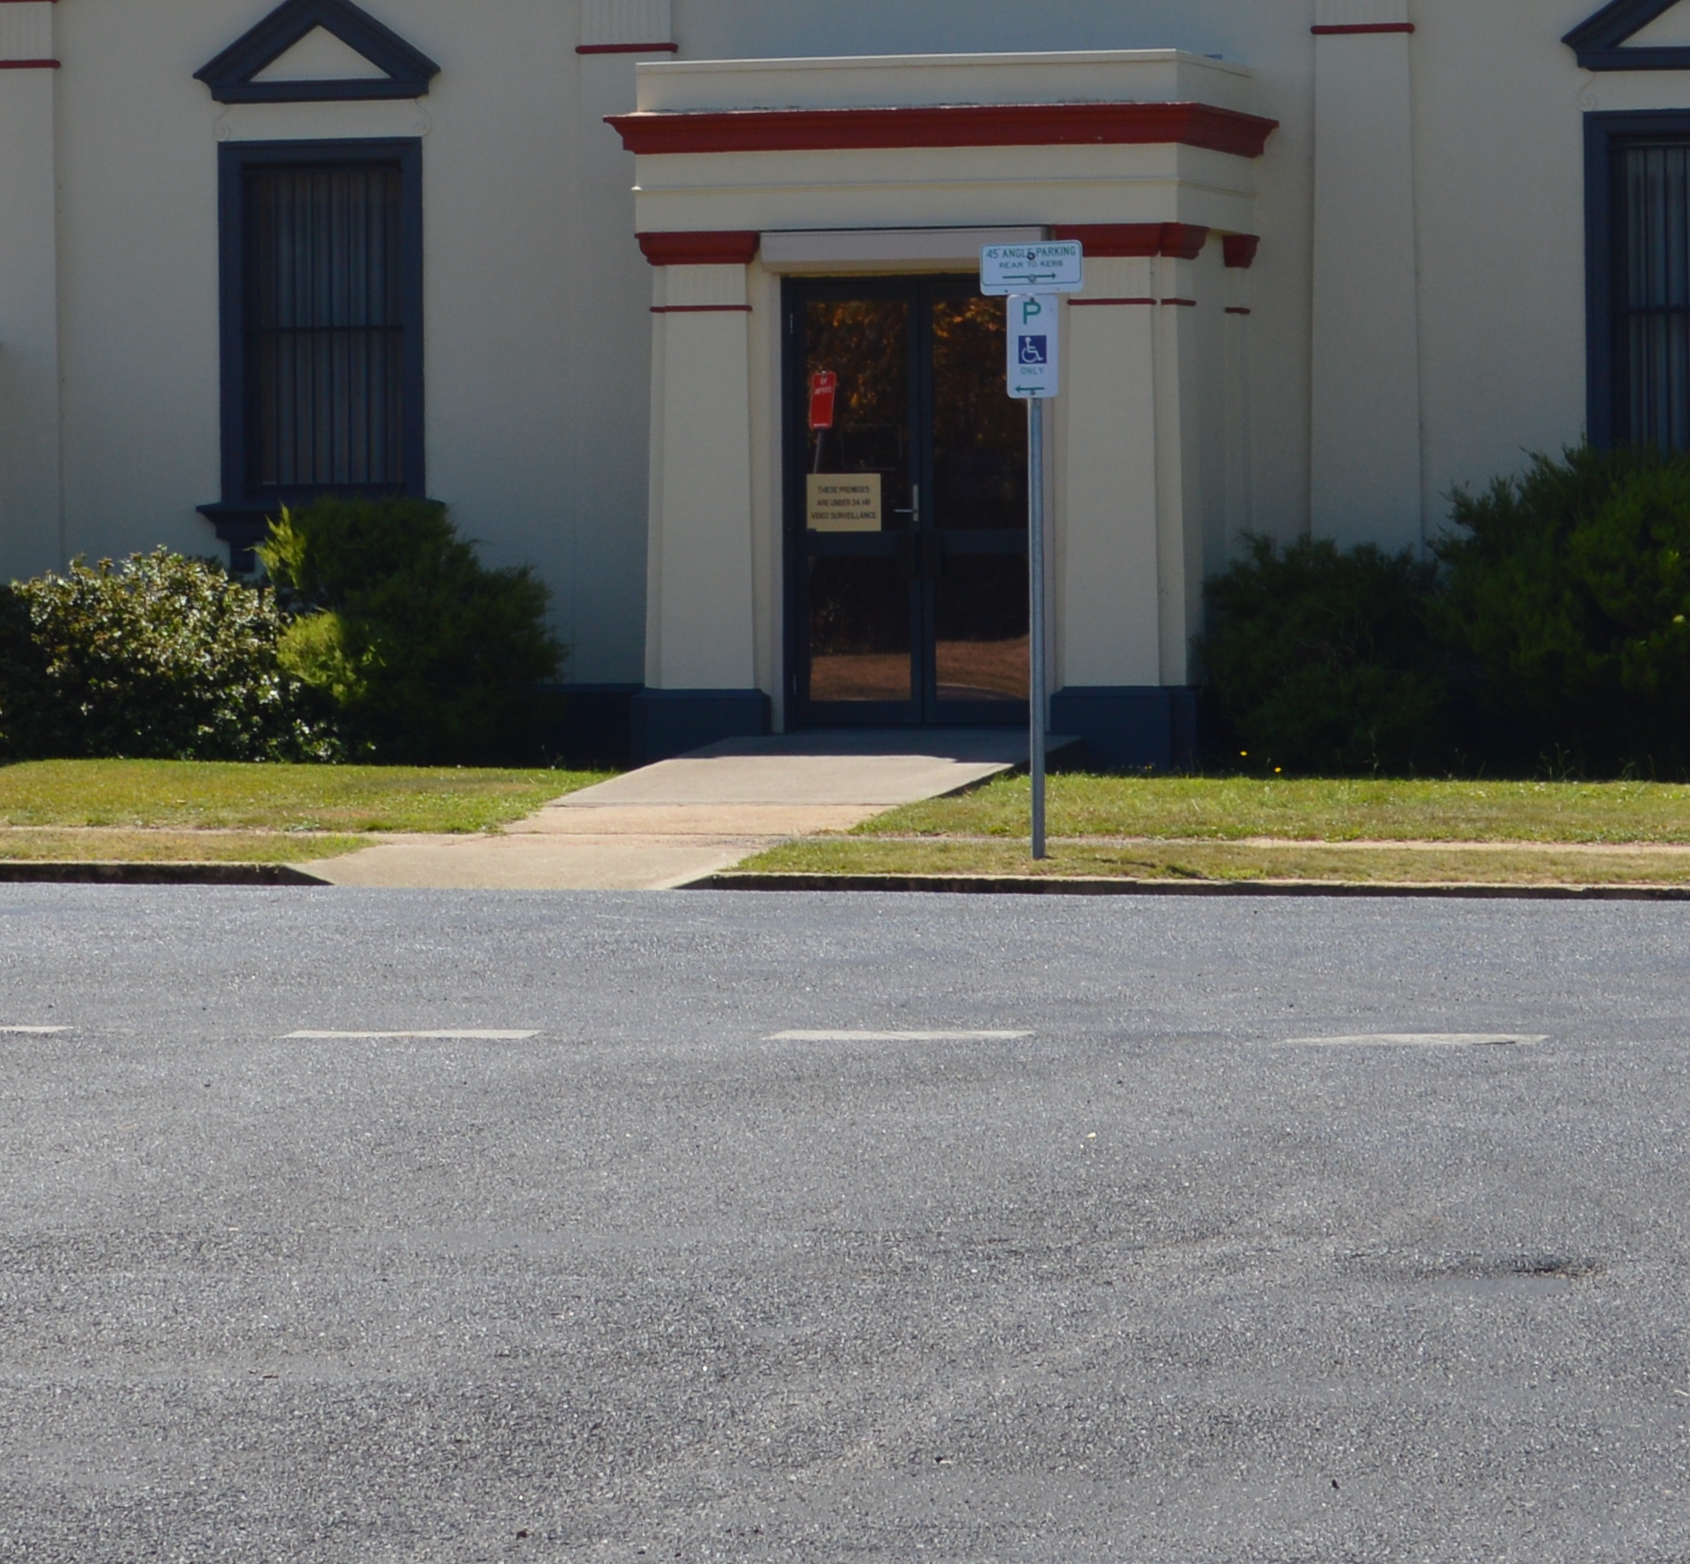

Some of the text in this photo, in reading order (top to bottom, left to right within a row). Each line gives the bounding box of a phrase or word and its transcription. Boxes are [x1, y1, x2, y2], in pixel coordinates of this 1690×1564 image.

[1002, 246, 1033, 258] ANGLE
[1036, 245, 1077, 257] PARKING
[998, 259, 1064, 269] REAR TO KERB
[1023, 301, 1042, 325] P
[1020, 366, 1045, 375] ONLY
